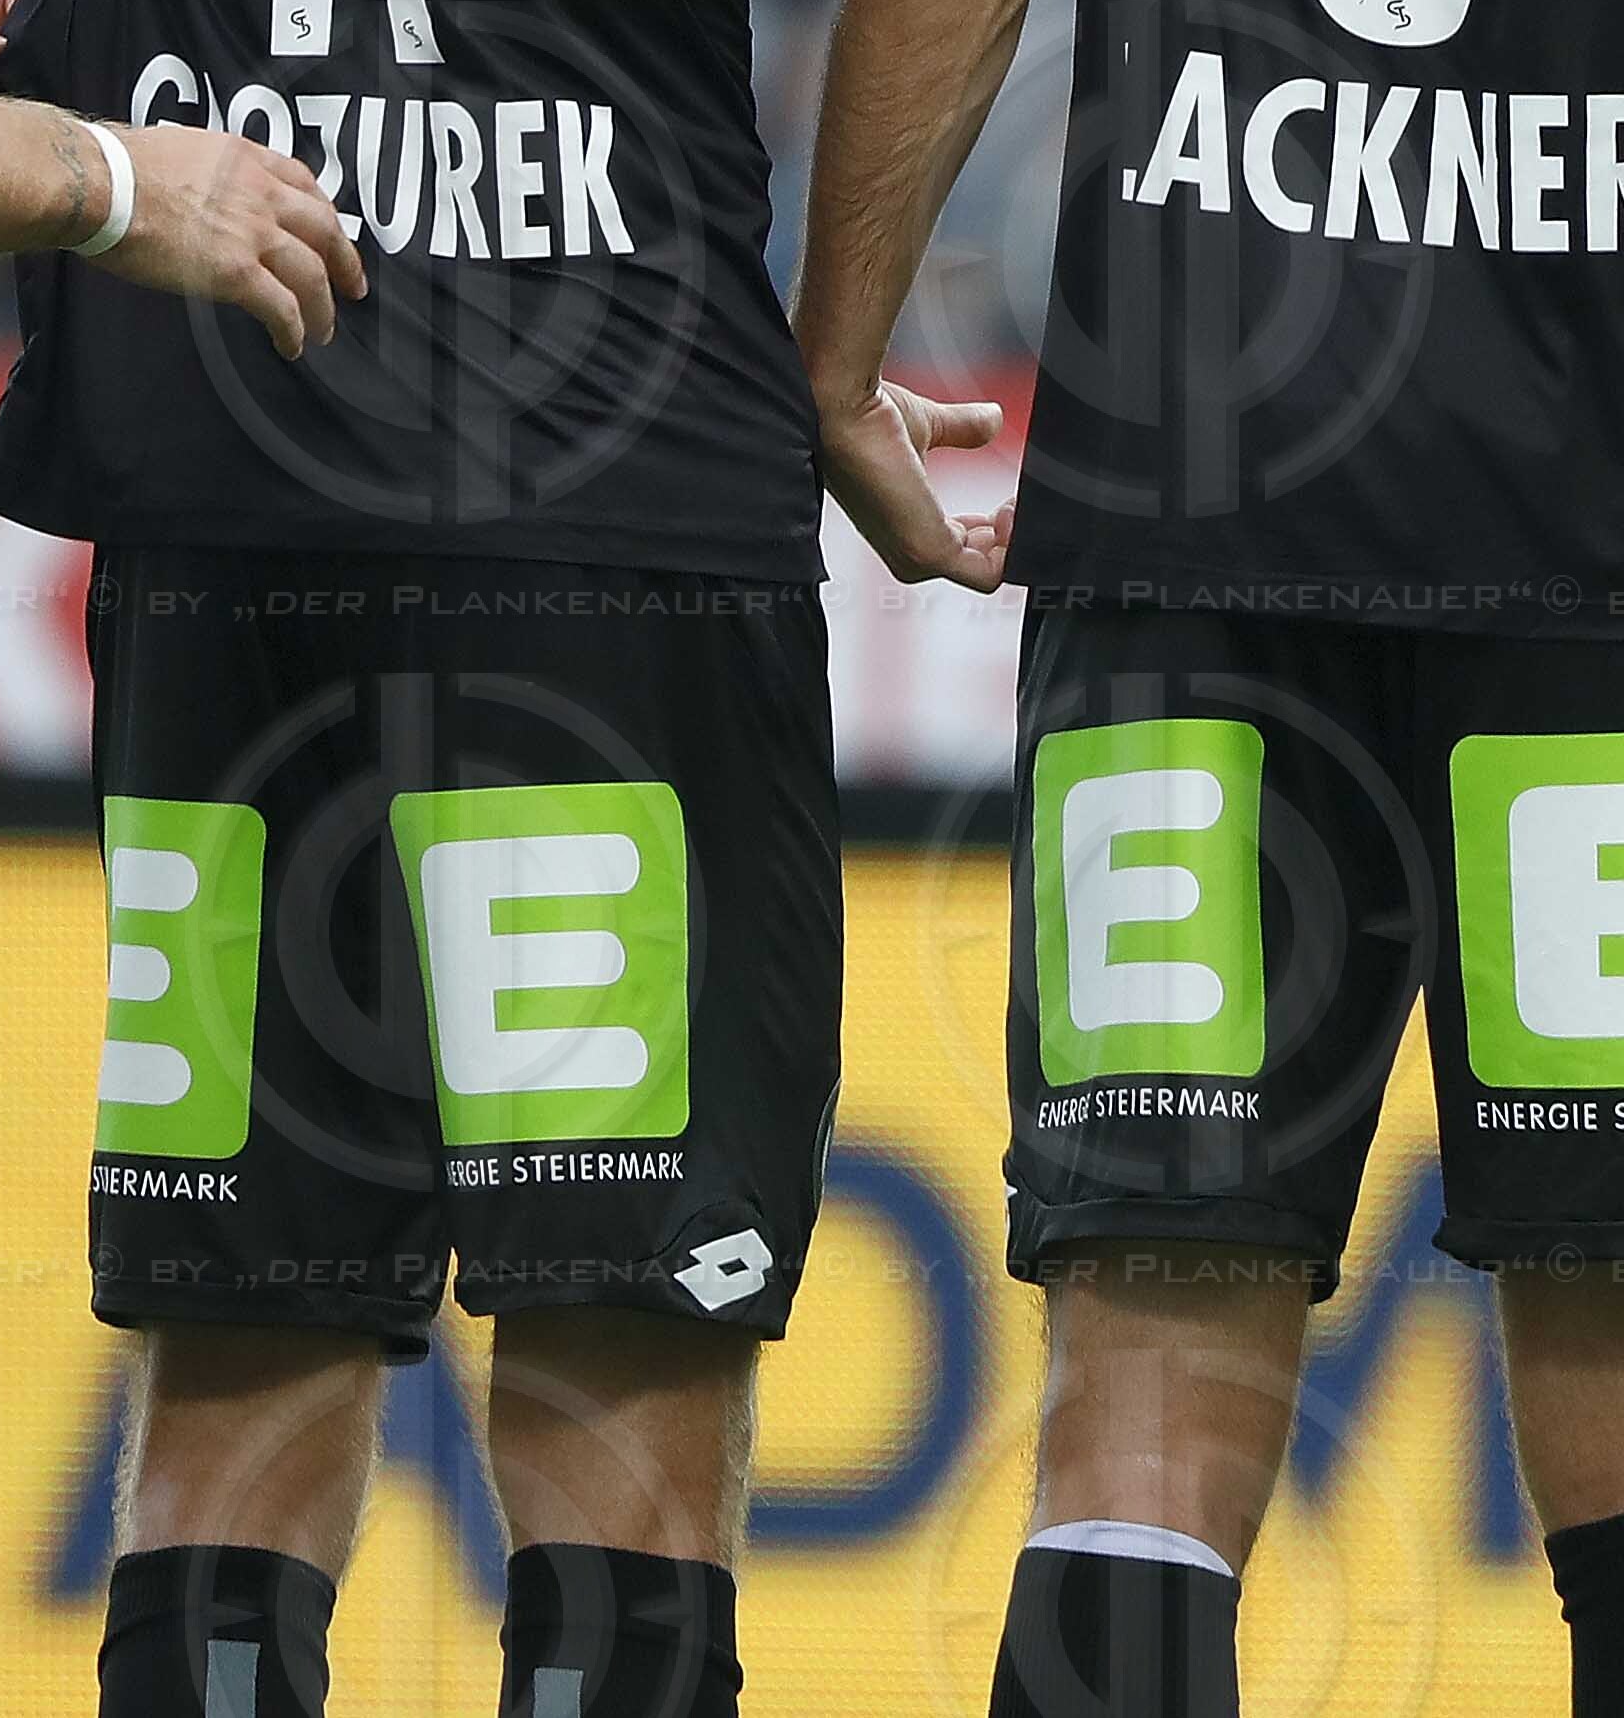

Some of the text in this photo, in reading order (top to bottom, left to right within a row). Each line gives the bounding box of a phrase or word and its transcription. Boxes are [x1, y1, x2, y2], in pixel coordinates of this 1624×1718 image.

[1096, 1087, 1260, 1120] STEIERMARK
[1476, 1101, 1598, 1131] ENERGIE
[512, 1152, 684, 1183] STEIERMARK
